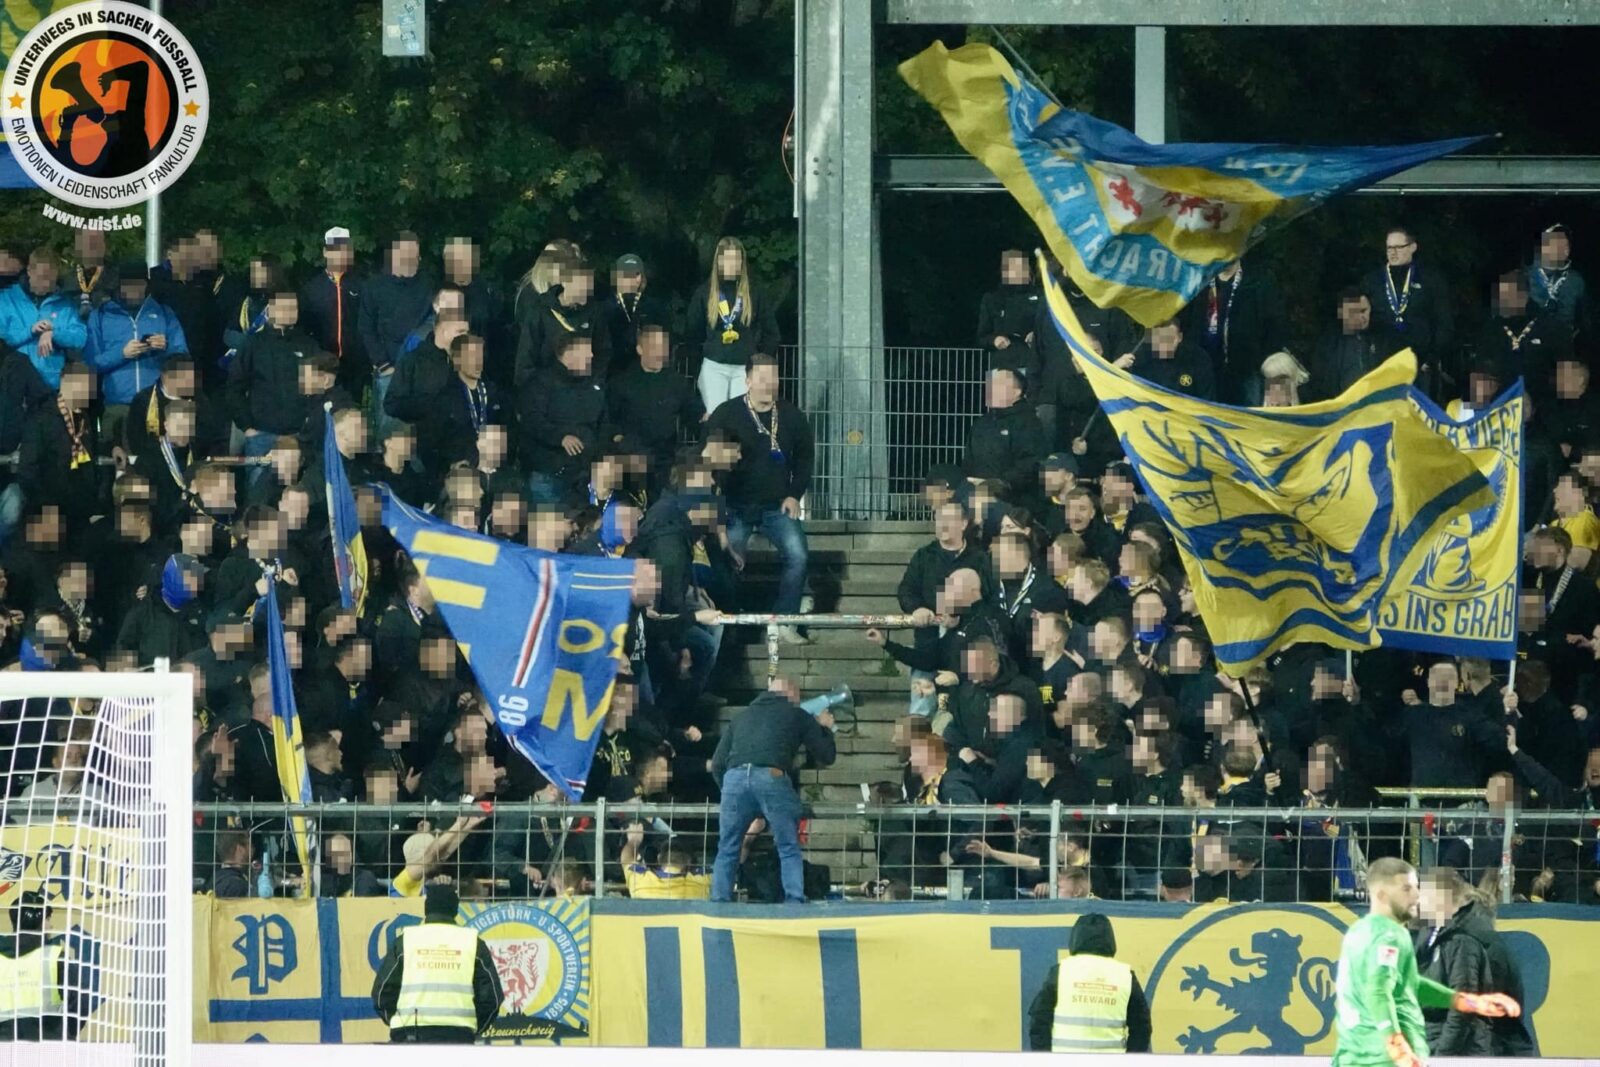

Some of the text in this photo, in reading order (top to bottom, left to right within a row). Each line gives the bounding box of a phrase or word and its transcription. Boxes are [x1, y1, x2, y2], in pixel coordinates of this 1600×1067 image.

[1405, 591, 1447, 633] INS
[416, 961, 462, 970] SECURITY
[547, 923, 577, 991] SPORTVEREIN
[1071, 994, 1117, 1006] STEWARD
